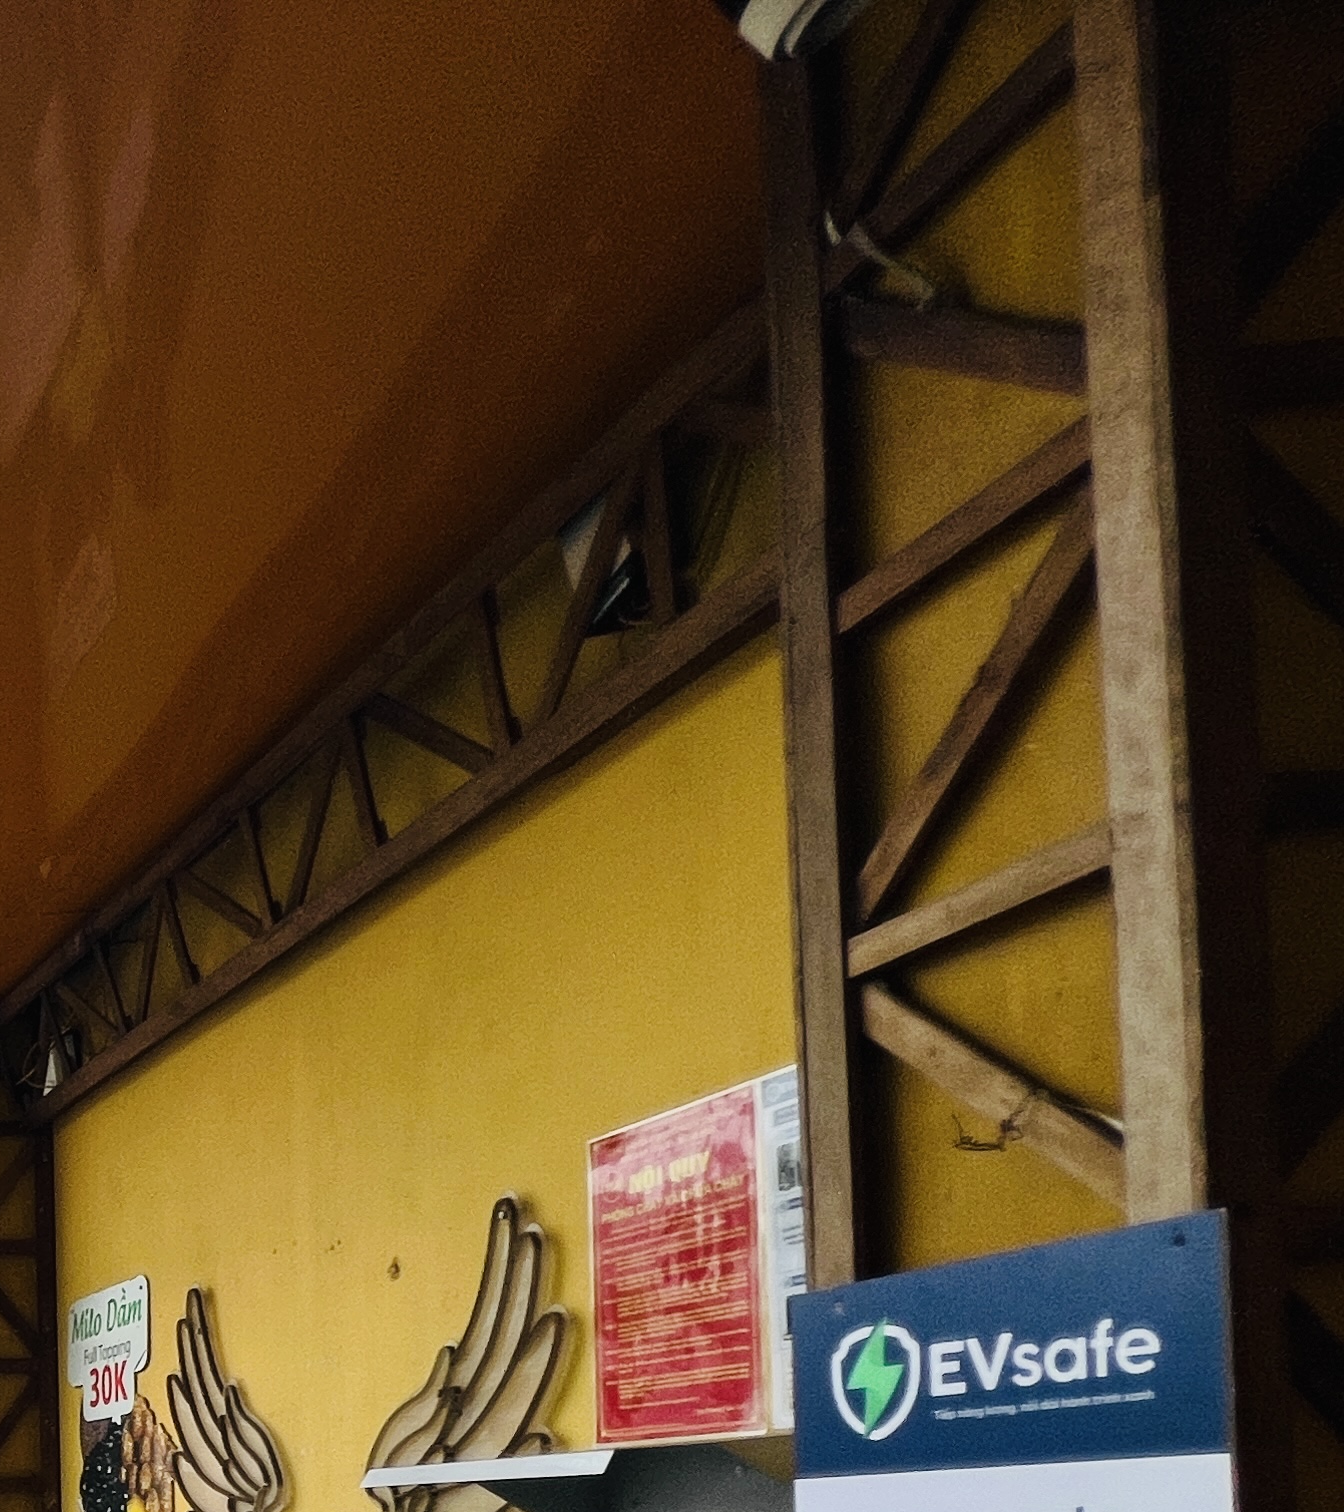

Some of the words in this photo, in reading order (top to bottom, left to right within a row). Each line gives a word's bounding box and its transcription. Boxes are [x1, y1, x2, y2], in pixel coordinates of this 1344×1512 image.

[72, 1308, 102, 1344] Milo
[929, 1318, 1162, 1398] EVsafe
[89, 1360, 128, 1408] 30K
